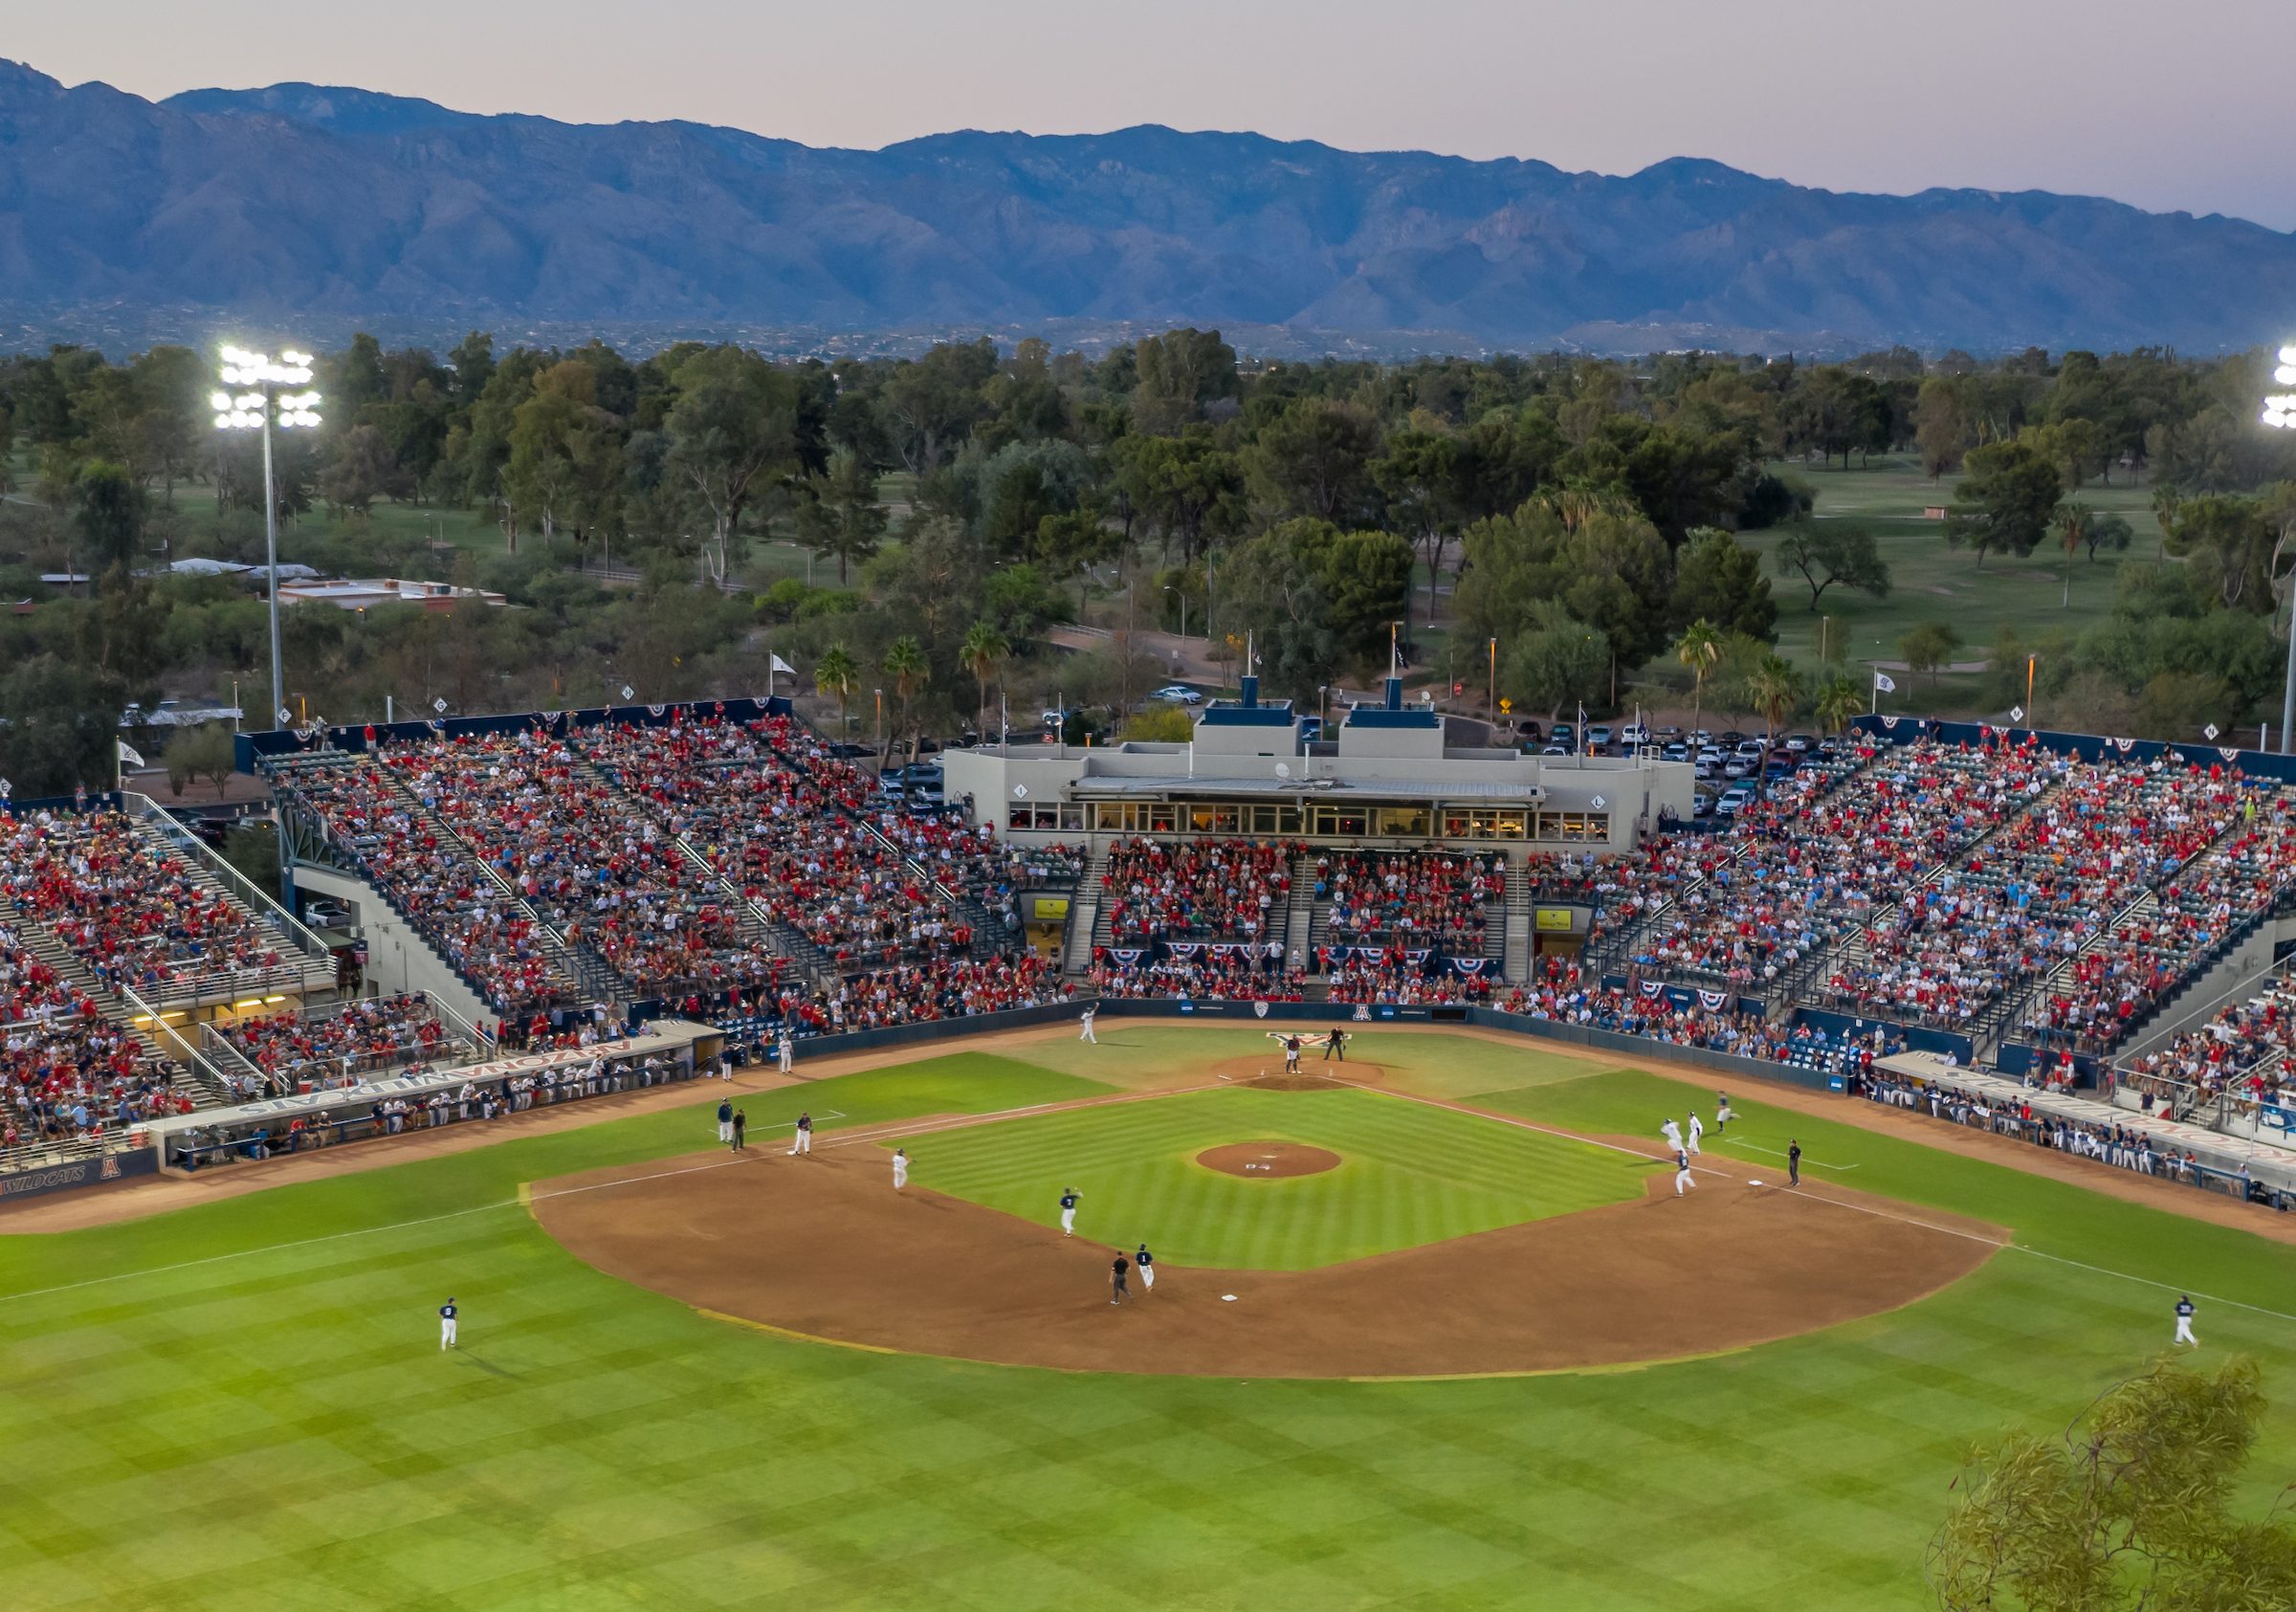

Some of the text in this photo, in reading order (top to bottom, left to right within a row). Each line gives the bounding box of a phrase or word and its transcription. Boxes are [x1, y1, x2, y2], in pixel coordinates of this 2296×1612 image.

[1353, 1004, 1372, 1021] A
[453, 1041, 631, 1078] ARIZONA
[3, 1166, 85, 1194] WILDCATS
[100, 1156, 121, 1179] A
